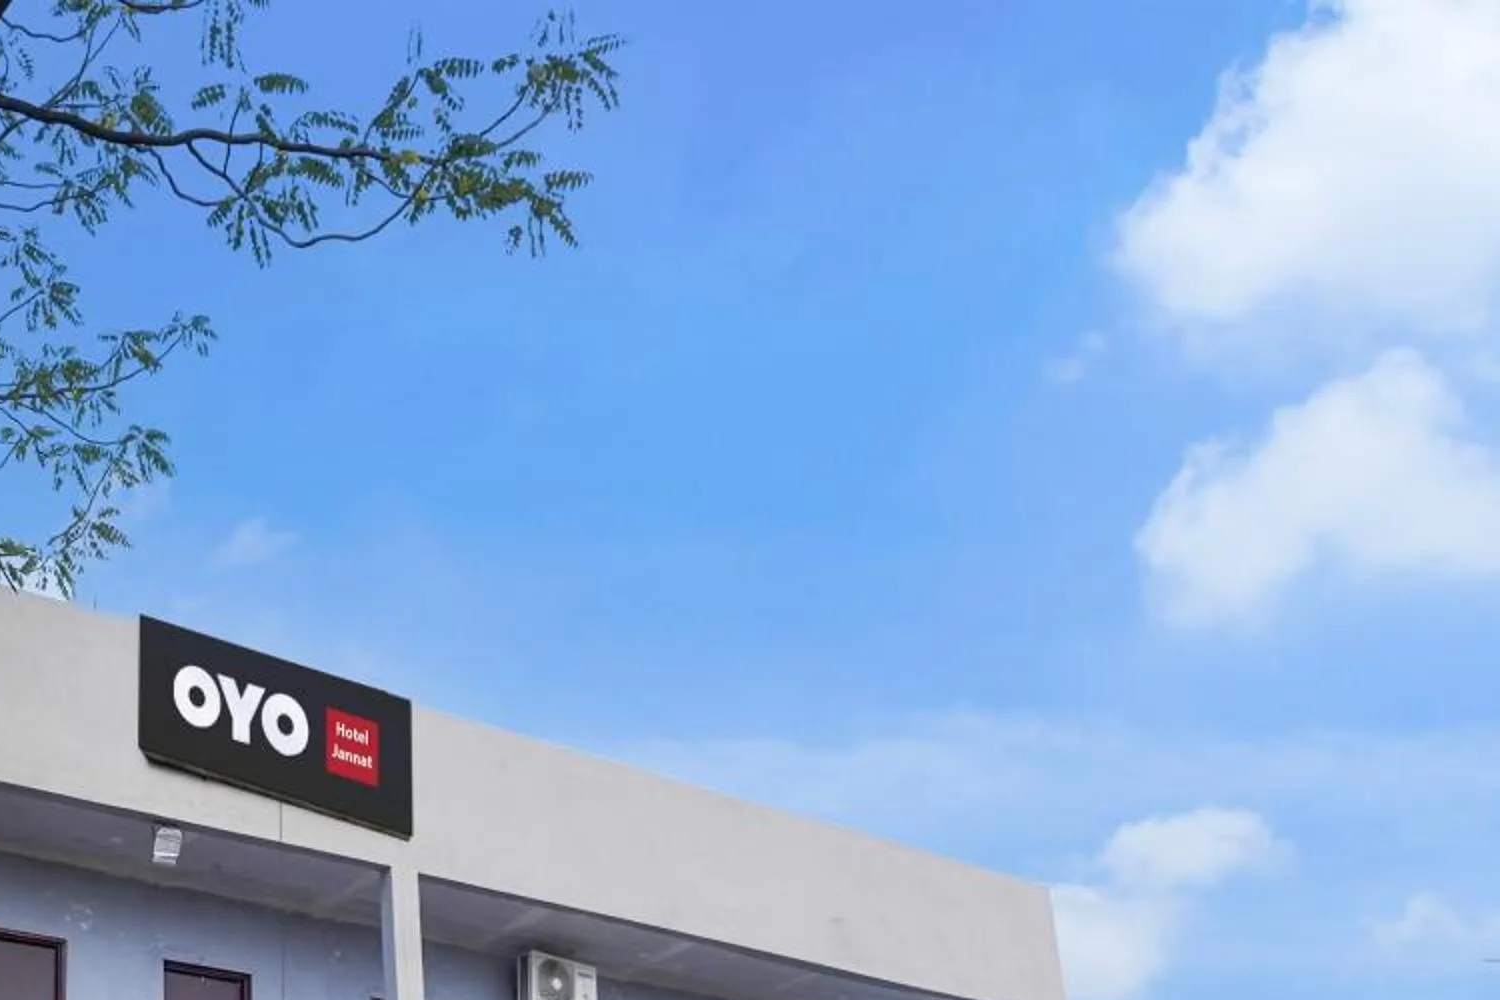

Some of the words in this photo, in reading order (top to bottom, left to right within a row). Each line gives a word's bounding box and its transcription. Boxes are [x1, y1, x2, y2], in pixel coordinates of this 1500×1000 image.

[173, 665, 309, 757] OYO
[335, 721, 369, 746] Hotel
[331, 743, 373, 769] Jannat
